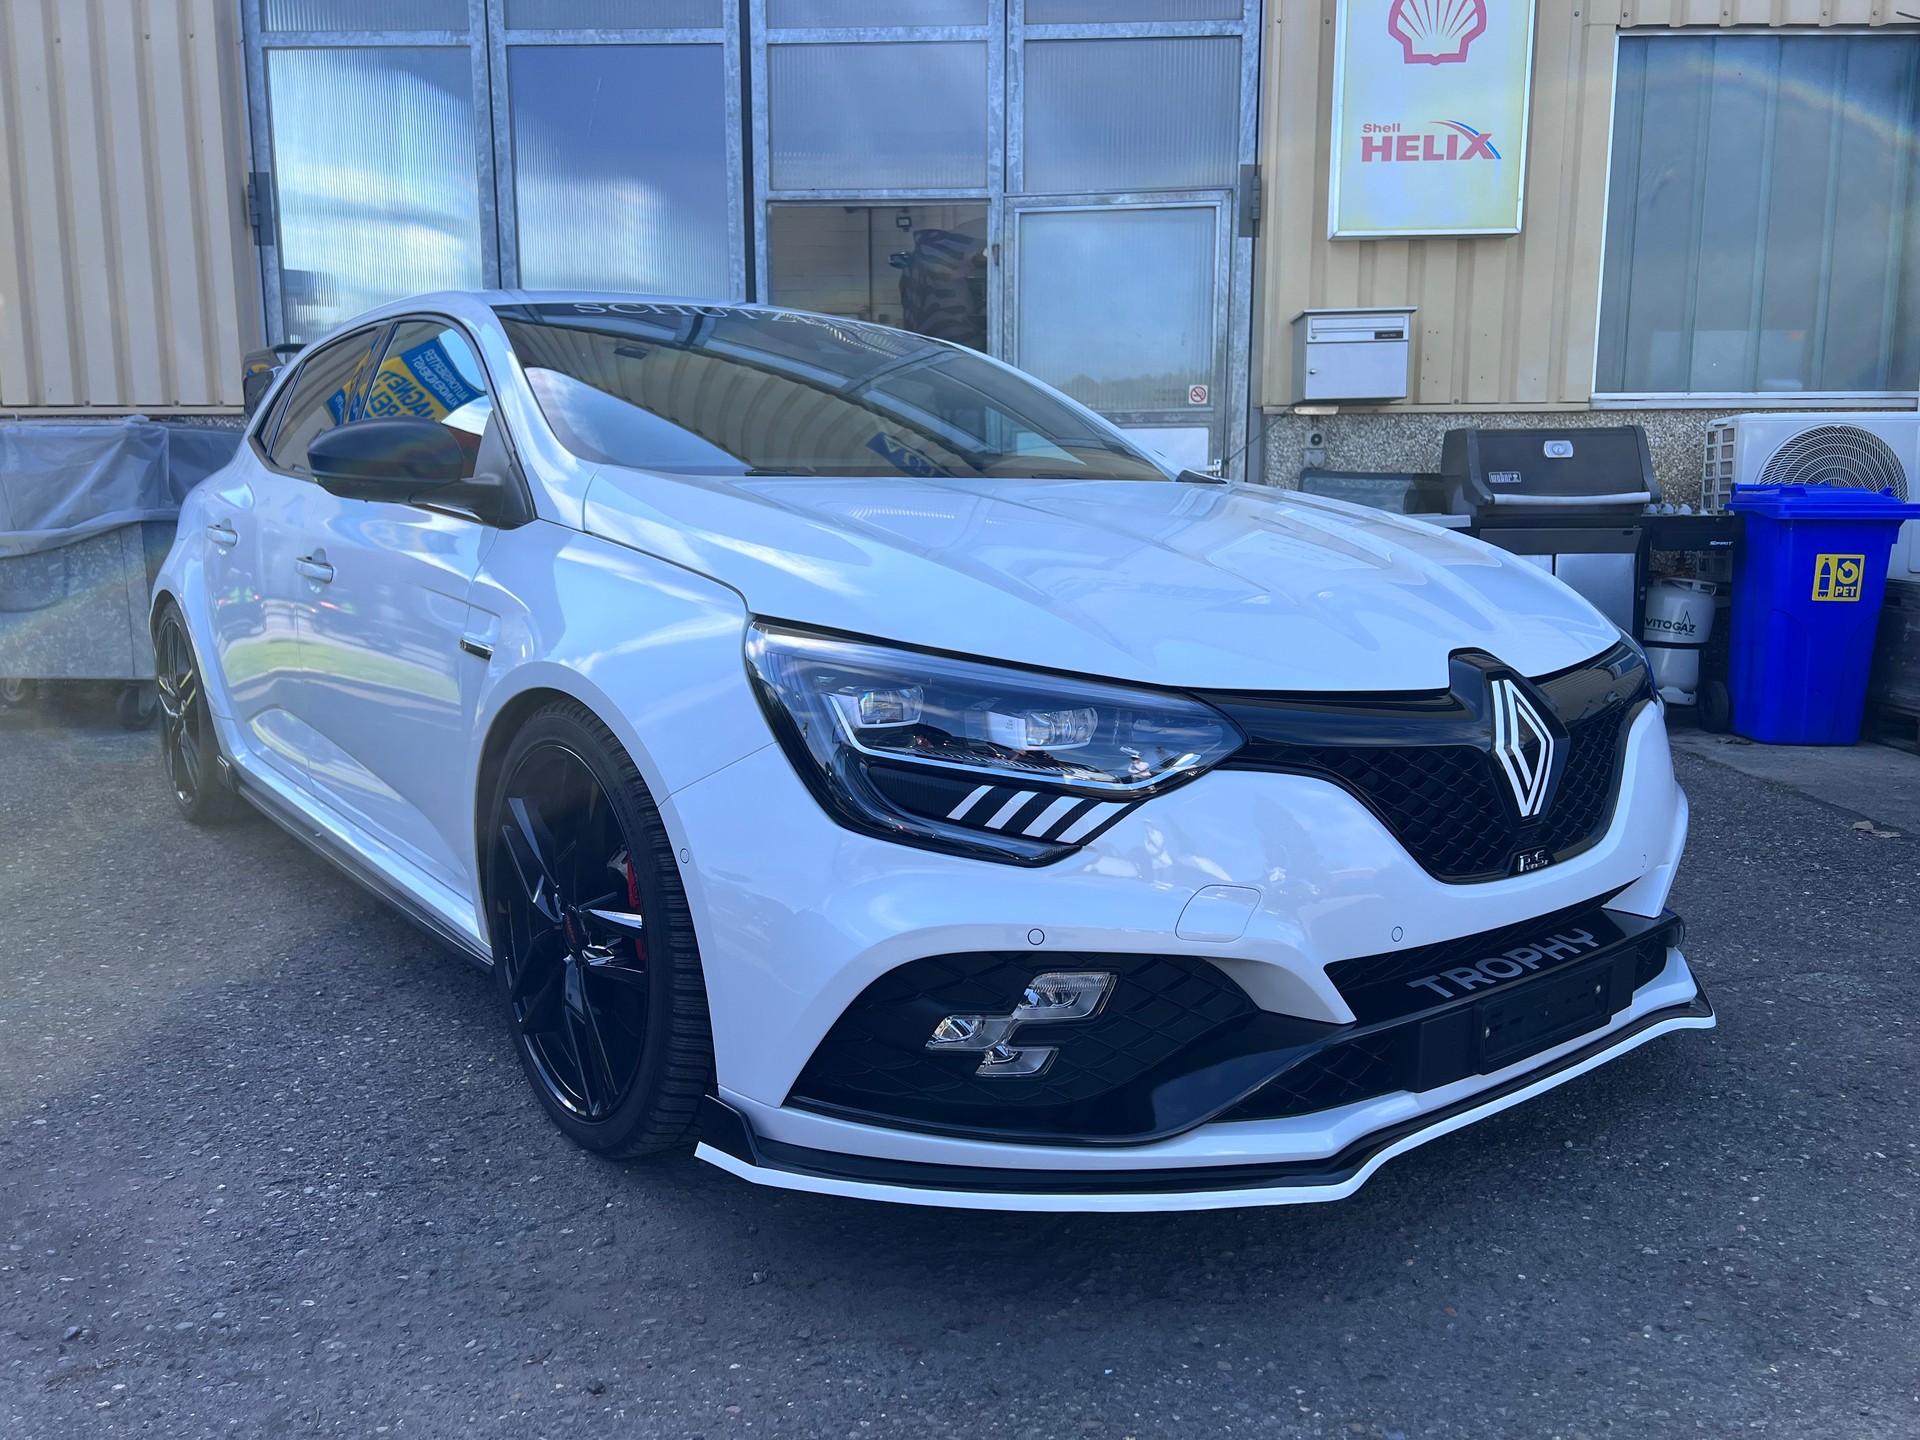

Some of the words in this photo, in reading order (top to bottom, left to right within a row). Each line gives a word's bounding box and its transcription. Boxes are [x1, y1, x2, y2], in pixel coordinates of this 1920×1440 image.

[1362, 122, 1401, 133] Shell
[1360, 131, 1498, 162] HELIX
[1834, 585, 1857, 597] PET
[1645, 613, 1697, 634] VITOGAZ
[1406, 927, 1600, 999] TROPHY
